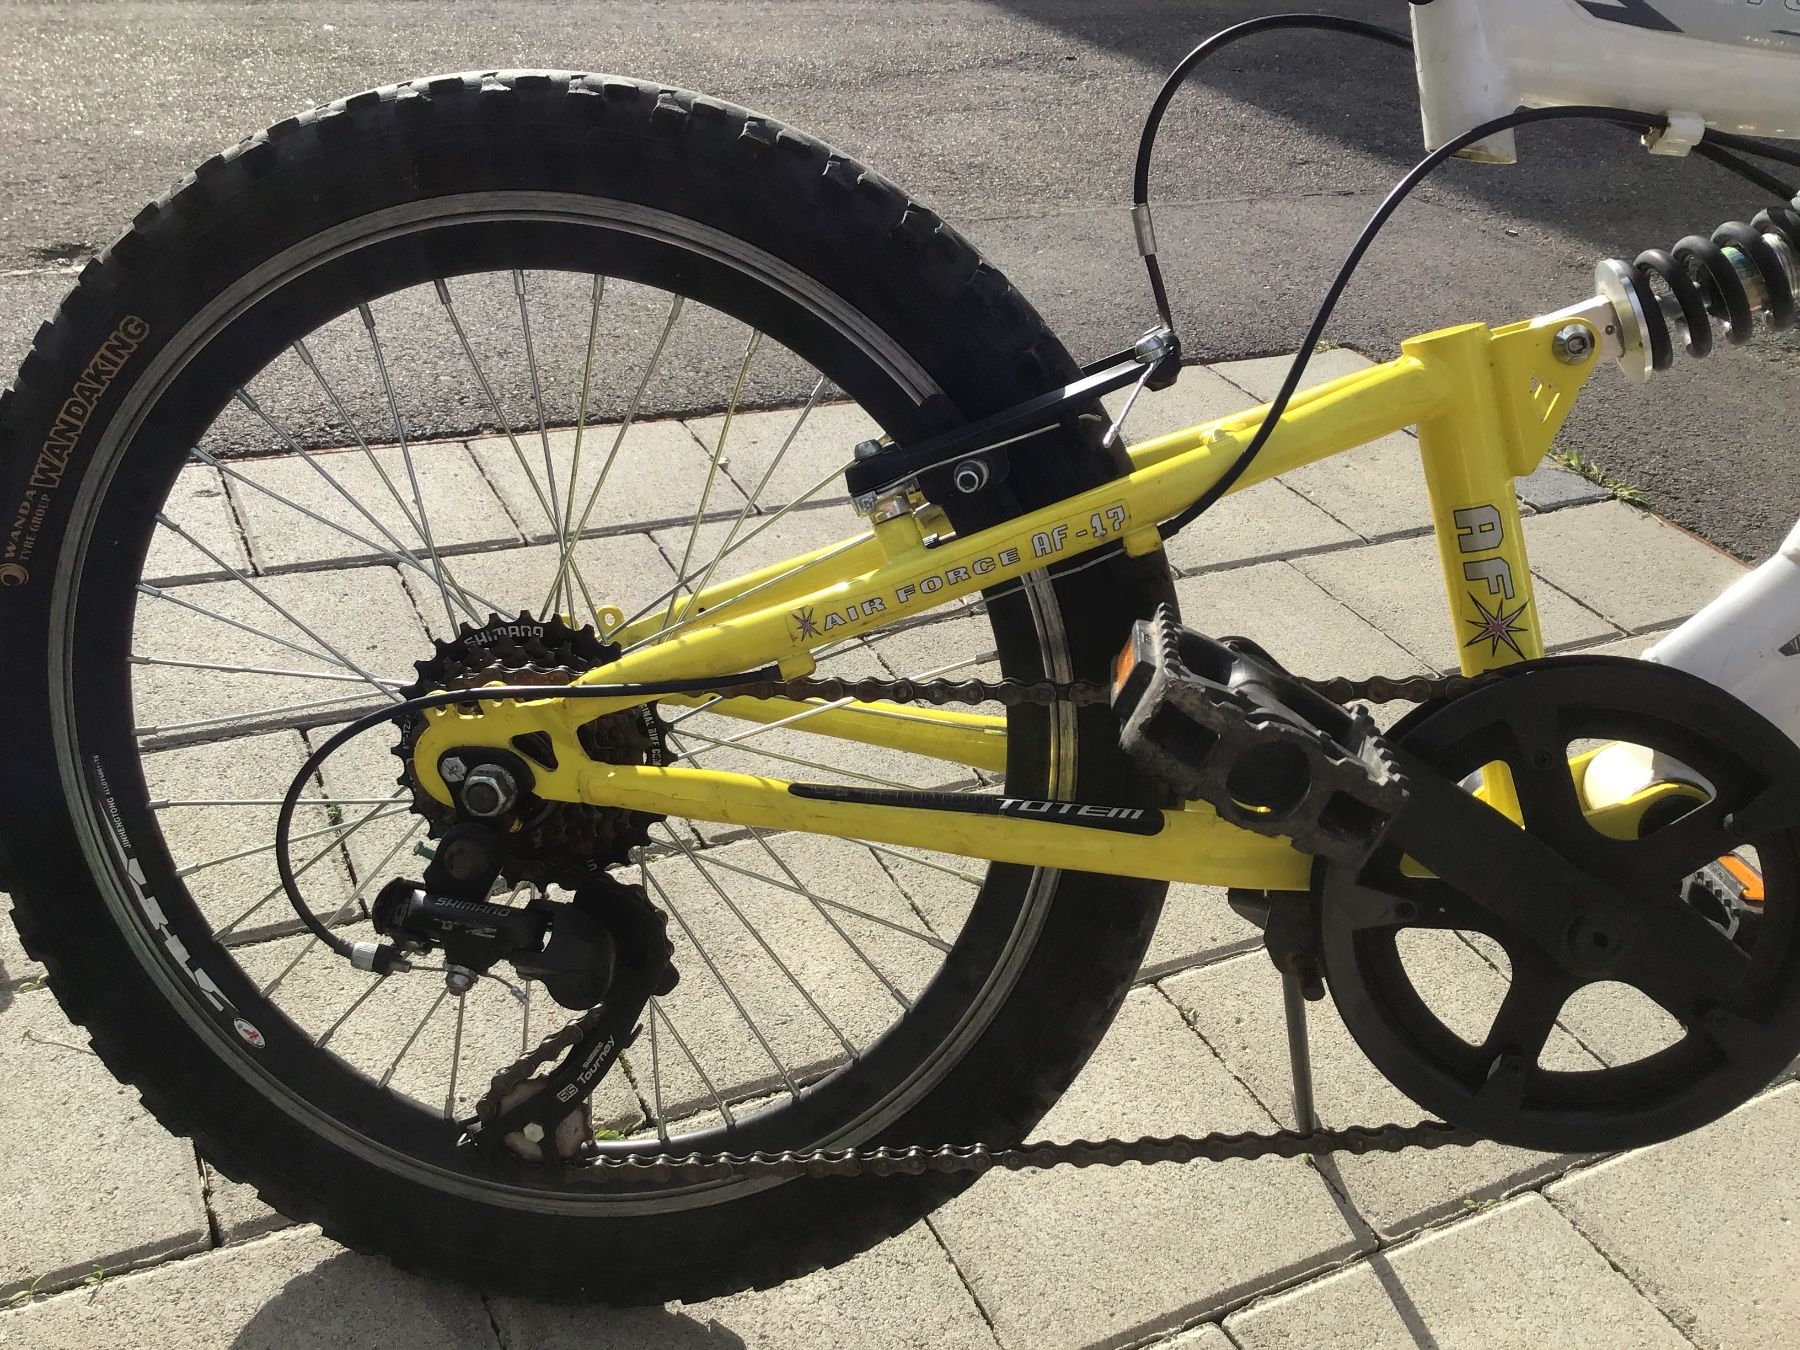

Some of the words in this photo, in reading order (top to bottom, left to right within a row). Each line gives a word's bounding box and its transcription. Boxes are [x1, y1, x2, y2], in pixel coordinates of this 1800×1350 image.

[29, 314, 150, 489] WANDAKING
[4, 489, 38, 558] WANDA
[19, 532, 37, 560] TYRE
[29, 493, 51, 532] GROUP
[1453, 504, 1516, 600] AF
[824, 596, 887, 631] AIR
[895, 547, 1021, 605] FORCE
[464, 623, 544, 646] SHIMANO
[107, 796, 132, 848] JINHENGTONG
[996, 797, 1145, 820] TOTEM
[434, 896, 512, 917] SHIMANO
[576, 1034, 615, 1084] Tourney
